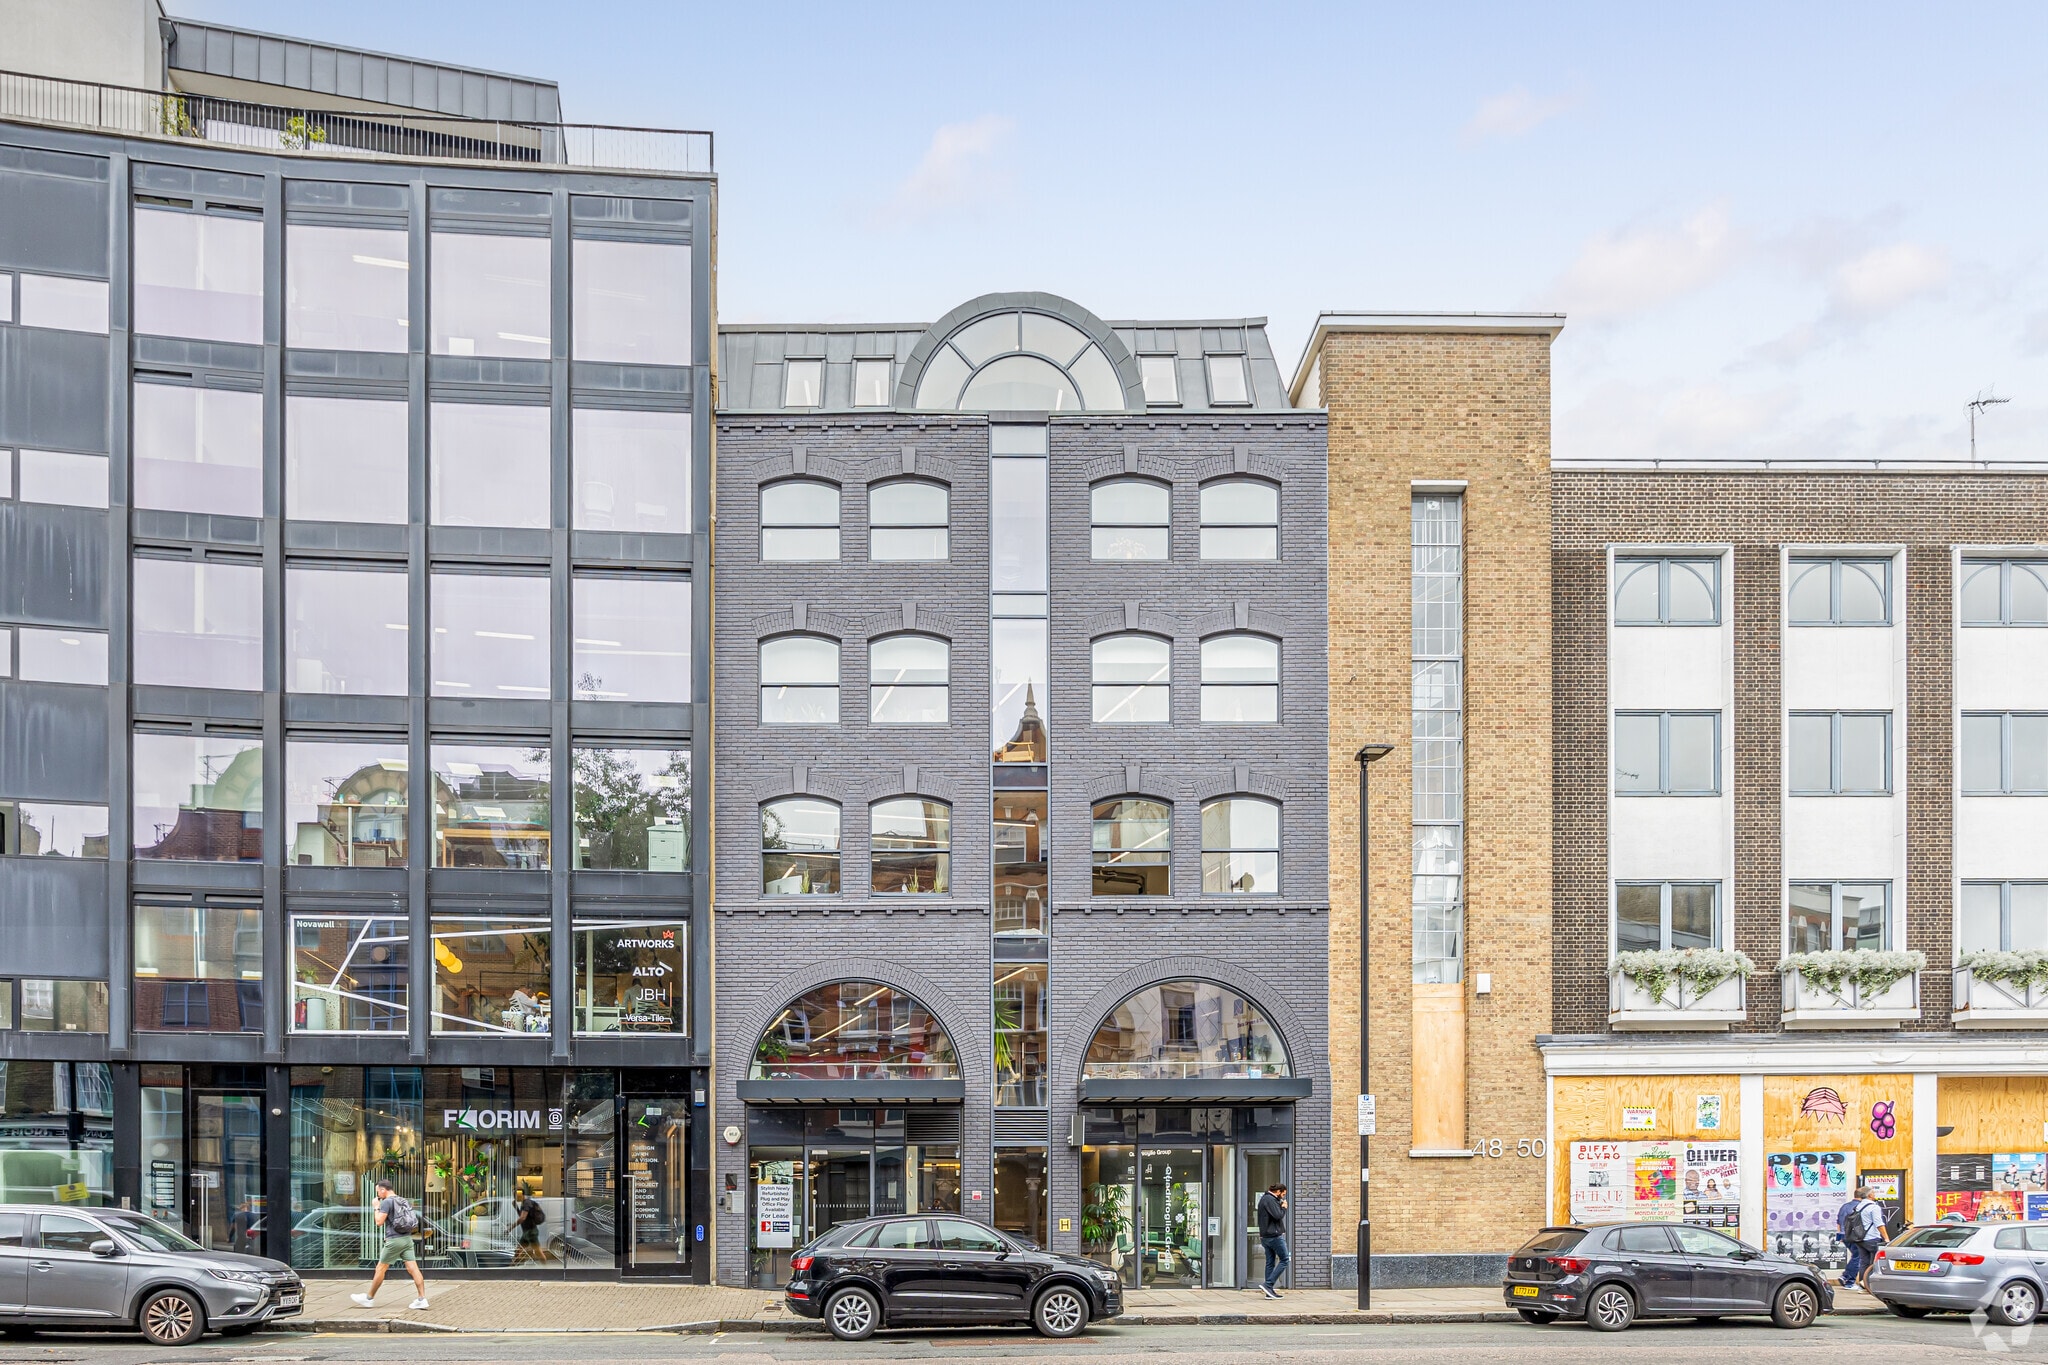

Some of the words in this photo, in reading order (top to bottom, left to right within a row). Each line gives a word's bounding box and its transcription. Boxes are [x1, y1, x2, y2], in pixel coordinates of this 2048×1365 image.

[617, 939, 675, 949] ARTWORKS
[633, 966, 665, 977] ALTO
[636, 988, 666, 1001] JBH
[625, 1013, 665, 1022] Versa-Tile
[1686, 1149, 1738, 1162] OLIVER
[1060, 1220, 1070, 1230] H
